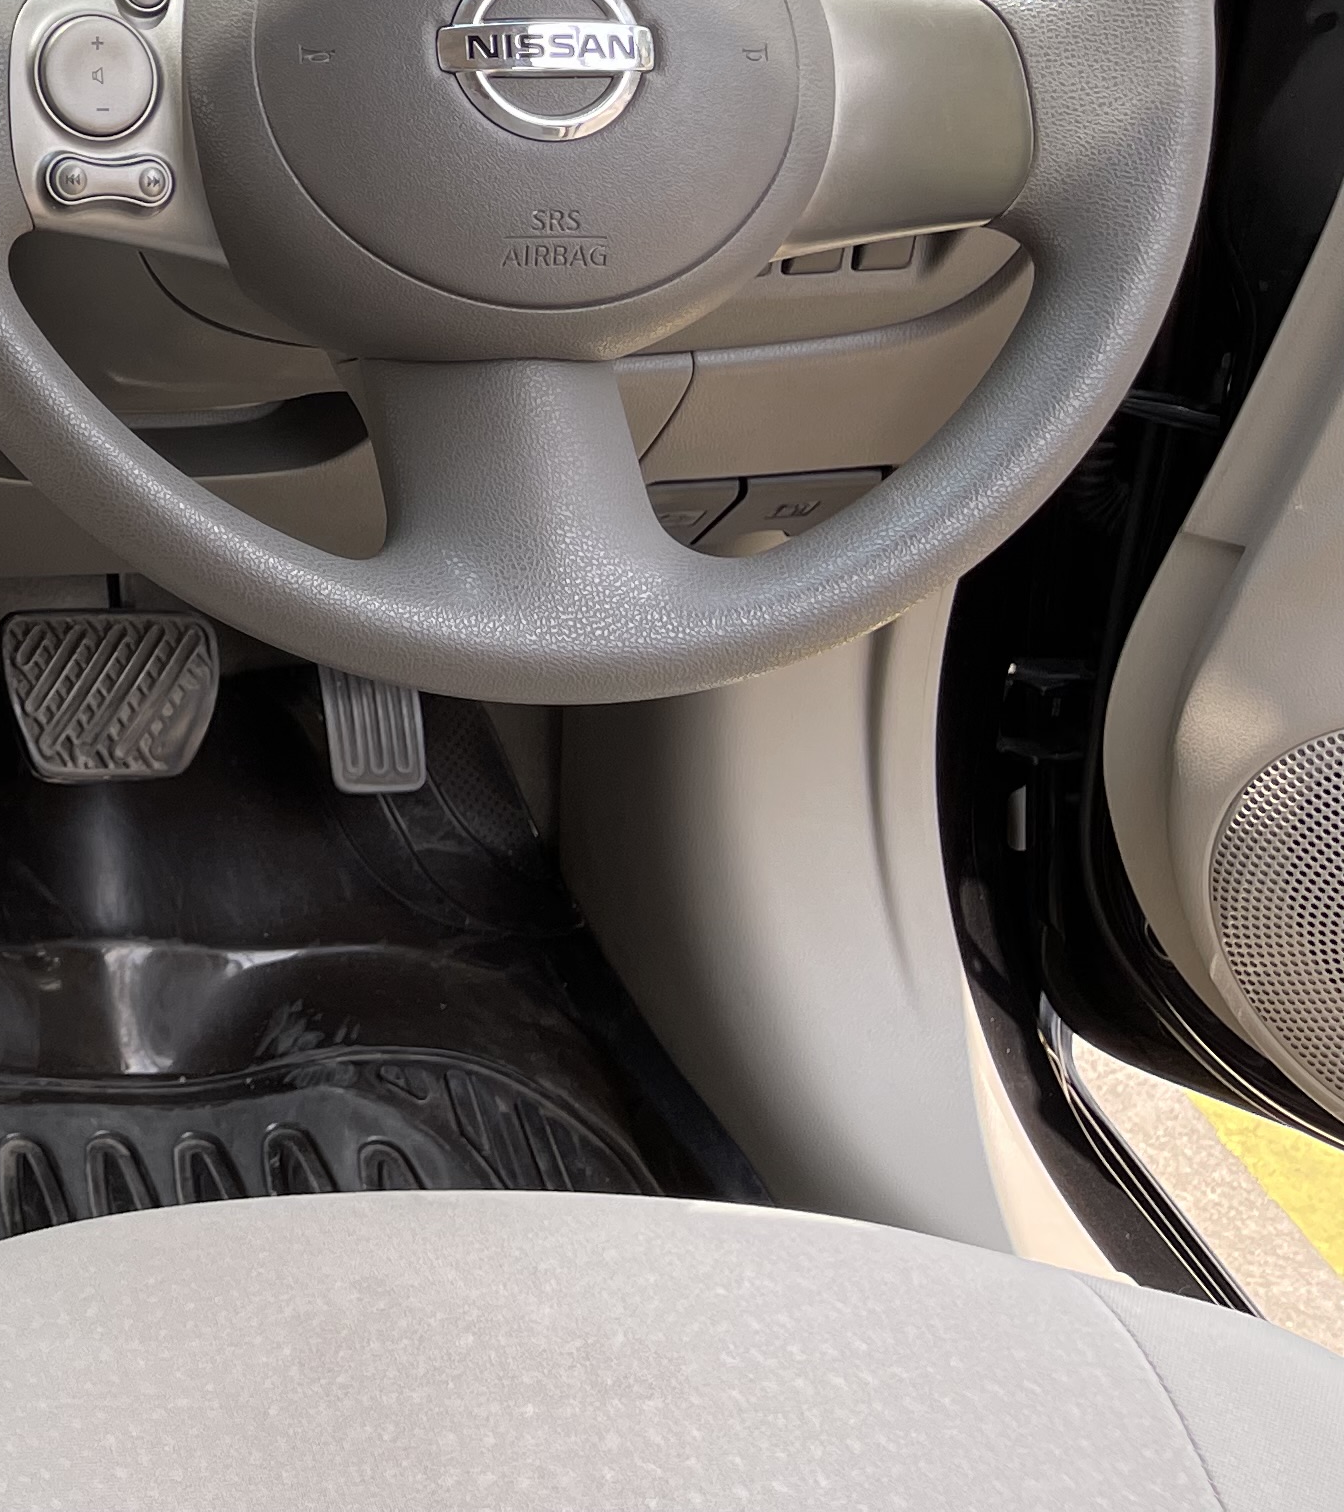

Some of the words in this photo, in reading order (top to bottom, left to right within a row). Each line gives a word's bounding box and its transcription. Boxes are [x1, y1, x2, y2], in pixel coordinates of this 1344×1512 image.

[466, 32, 638, 62] NISSAN
[530, 209, 583, 233] SRS
[500, 243, 610, 268] AIRBAG
